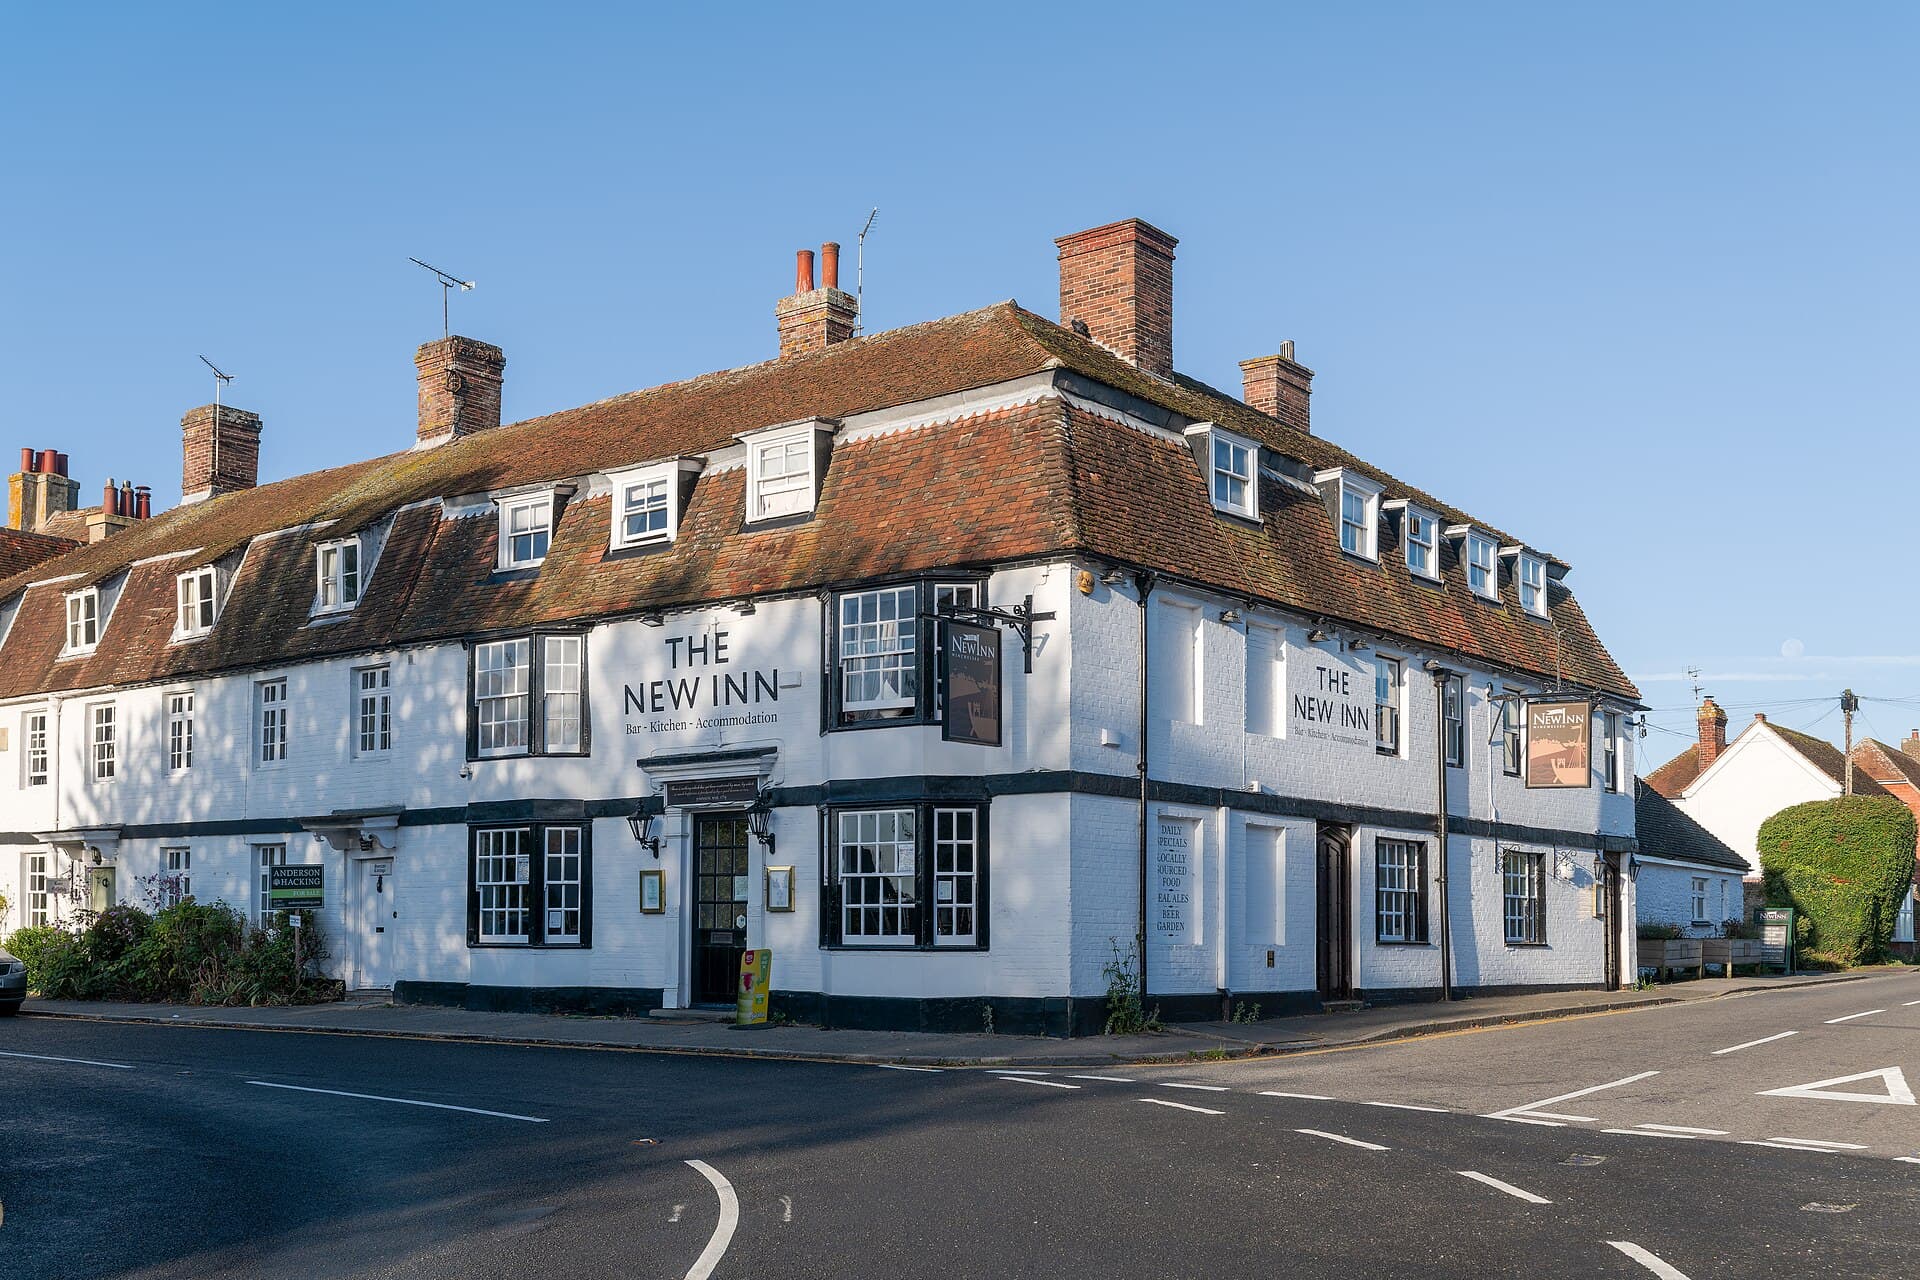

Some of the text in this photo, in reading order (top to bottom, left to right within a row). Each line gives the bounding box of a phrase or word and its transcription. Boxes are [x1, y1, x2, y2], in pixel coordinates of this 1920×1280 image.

[665, 632, 729, 669] THE
[1316, 666, 1350, 696] THE
[624, 668, 778, 715] NEW INN
[1294, 694, 1369, 731] NEW INN
[626, 723, 642, 735] Bar
[650, 719, 688, 733] Kitchen
[696, 711, 778, 729] Accommodation
[1161, 824, 1183, 836] DAILY
[1158, 836, 1188, 848] PECIALS
[273, 869, 320, 877] ANDERSON
[281, 877, 321, 886] HACKING
[1162, 877, 1181, 887] FOOD
[1158, 893, 1189, 903] EAL ALES
[1162, 909, 1180, 919] BEER
[1157, 921, 1185, 931] GARDEN
